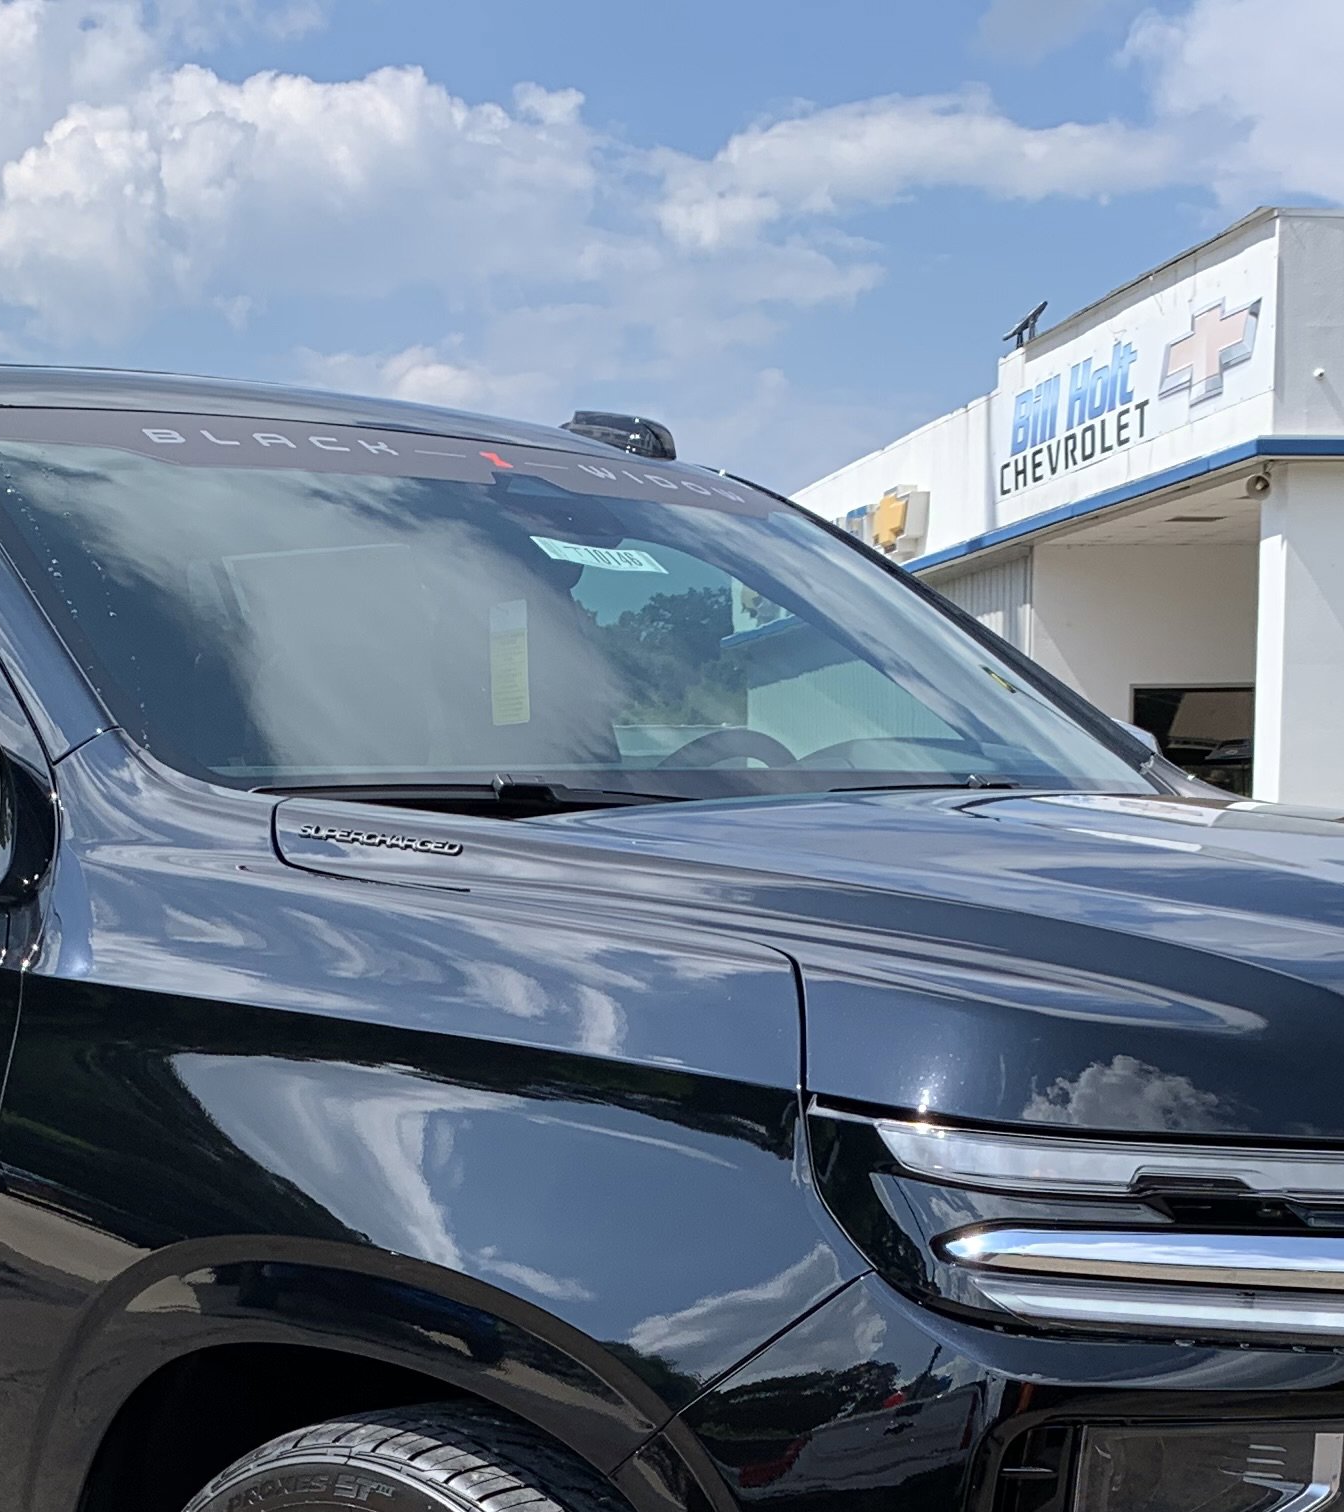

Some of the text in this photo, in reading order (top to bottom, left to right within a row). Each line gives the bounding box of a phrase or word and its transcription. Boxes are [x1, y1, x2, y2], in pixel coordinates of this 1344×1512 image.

[1009, 340, 1138, 458] Bill Holt
[142, 428, 746, 503] BLACK WIDOW
[1000, 399, 1150, 497] CHEVROLET
[299, 824, 464, 857] SUPERCHARGED
